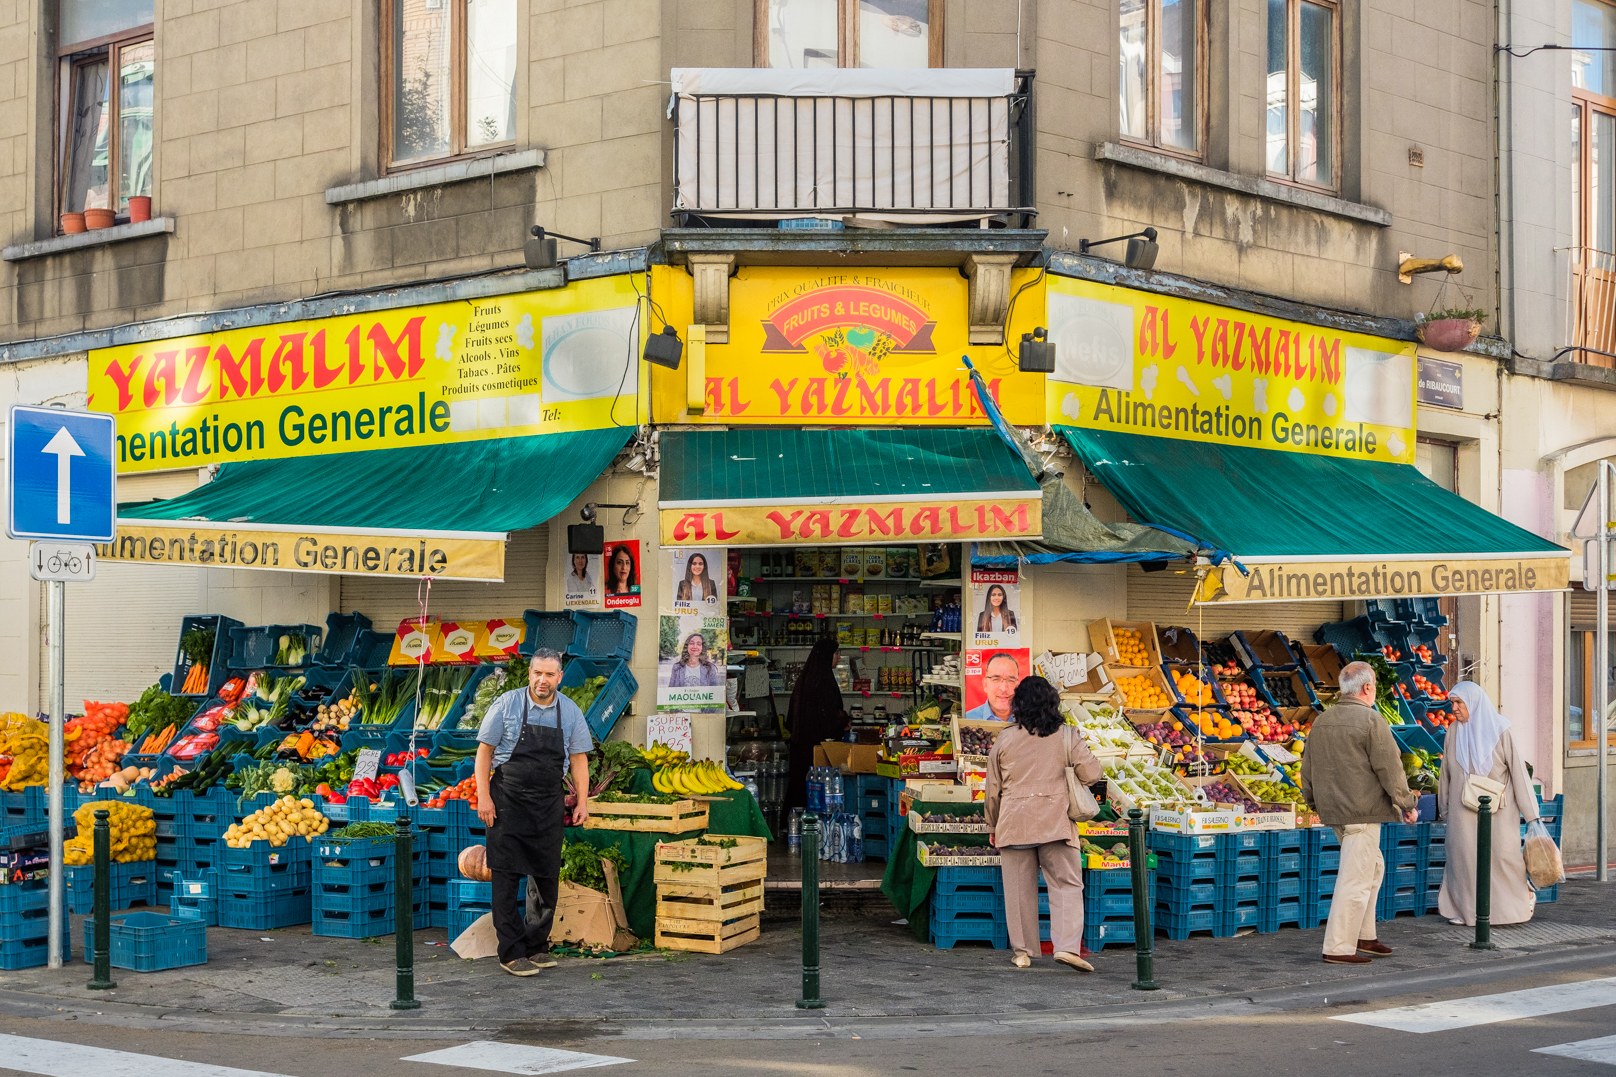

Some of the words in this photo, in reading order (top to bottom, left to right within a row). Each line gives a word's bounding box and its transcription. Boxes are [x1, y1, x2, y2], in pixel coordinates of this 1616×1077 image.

[767, 290, 790, 312] PRIX
[793, 275, 848, 296] QUALITE
[852, 275, 861, 285] &
[865, 276, 931, 312] FRAICHEUR
[474, 305, 502, 317] Fruits
[783, 303, 830, 336] FRUITS
[834, 301, 845, 316] &
[850, 301, 917, 335] LEGUMES
[469, 319, 510, 334] Légumes
[465, 336, 493, 348] Fruits
[494, 334, 513, 345] secs
[1139, 304, 1178, 360] AL
[1189, 315, 1342, 386] YAZMALIM
[104, 315, 427, 412] YAZMALIM
[459, 351, 492, 364] Alcools
[499, 348, 520, 359] Vins
[457, 368, 489, 379] Tabacs
[497, 362, 521, 375] Pâtes
[442, 383, 480, 396] Produits
[482, 377, 538, 390] cosmetiques
[1418, 379, 1425, 388] de
[1426, 380, 1461, 394] RIBAUCOURT
[704, 376, 752, 415] AL
[769, 377, 1003, 416] YAZMALIM
[278, 392, 451, 447] Generale
[542, 408, 562, 422] Tel:
[1093, 387, 1262, 441] Alimentation
[1271, 411, 1377, 455] Generale
[673, 511, 741, 541] AL
[765, 503, 1031, 538] YAZMALIM
[293, 536, 448, 574] Generale
[674, 550, 684, 559] LB
[973, 572, 1015, 581] Ikazban
[1245, 563, 1422, 598] Alimentation
[1430, 561, 1537, 592] Generale
[975, 639, 999, 647] URUŞ
[966, 654, 980, 664] PS
[654, 716, 687, 726] SUPER
[649, 725, 689, 736] PROMO
[1161, 815, 1181, 824] SALERNO
